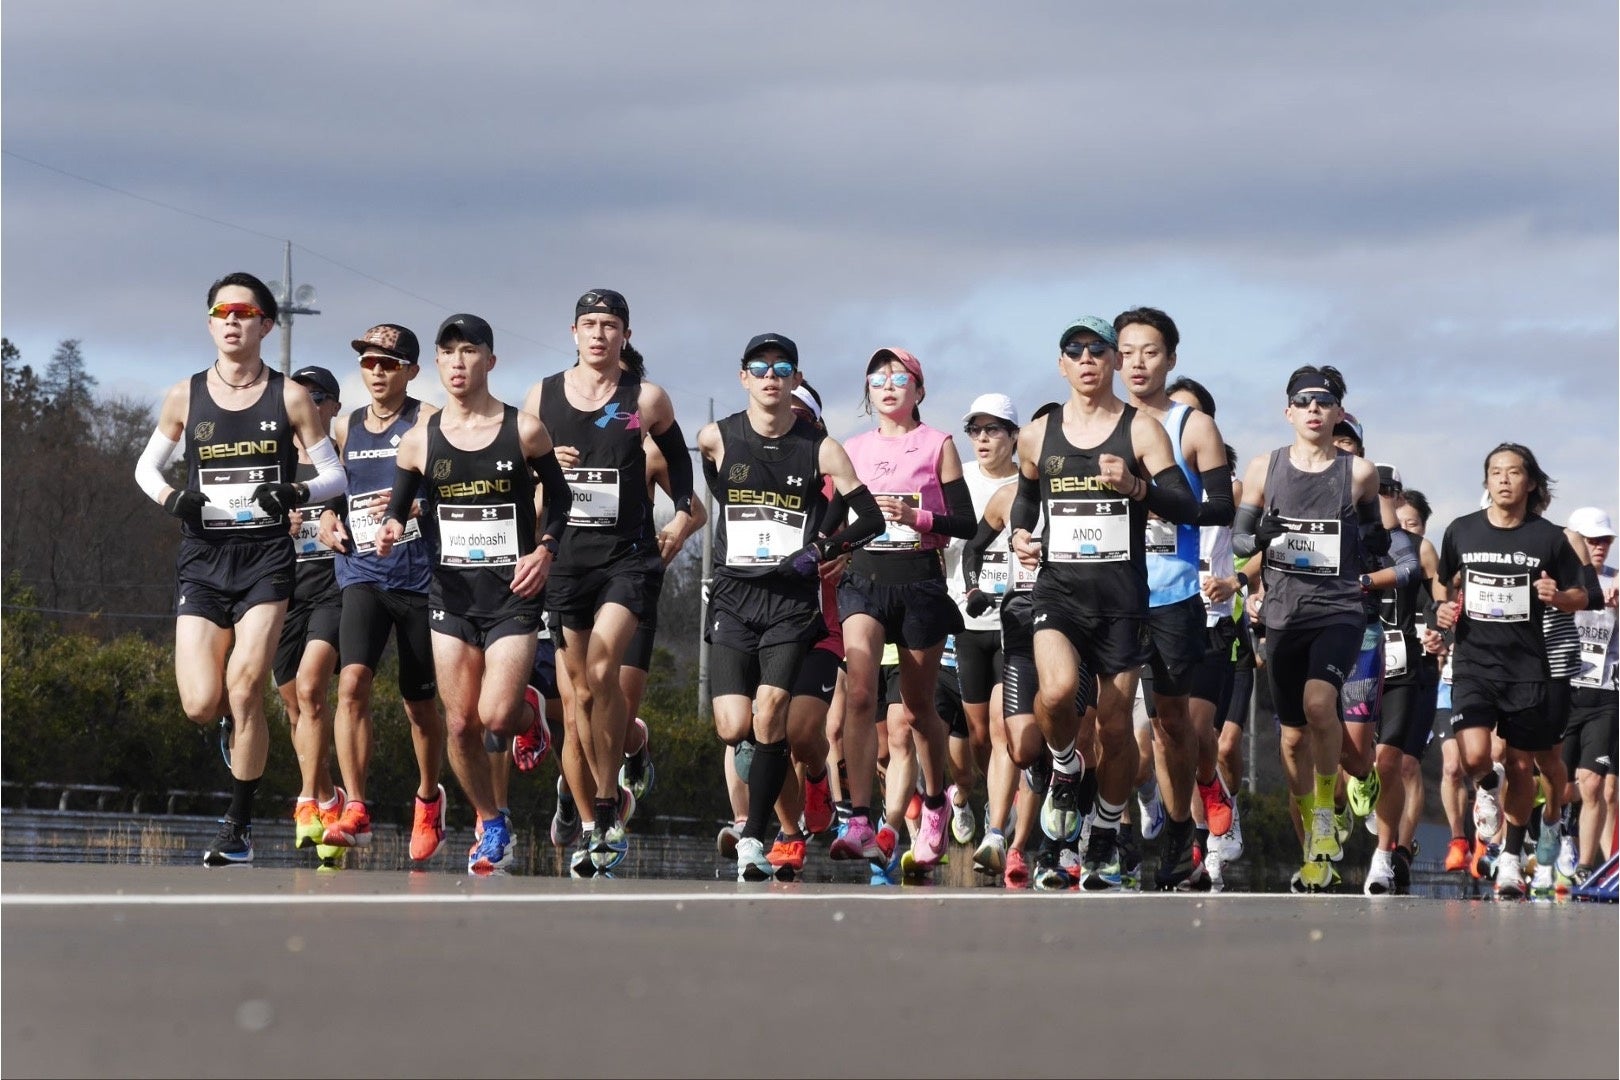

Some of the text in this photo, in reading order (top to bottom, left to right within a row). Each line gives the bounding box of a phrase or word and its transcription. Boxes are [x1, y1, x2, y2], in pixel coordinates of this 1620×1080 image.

[198, 439, 278, 460] BEYOND
[438, 479, 511, 498] BEYOND
[1050, 476, 1119, 493] BEYON
[728, 488, 801, 509] BEYOND
[449, 531, 507, 547] yuto dobashi
[1072, 528, 1103, 541] ANDO
[1287, 538, 1315, 552] KUNI
[981, 568, 1007, 581] Shige
[1018, 571, 1024, 580] B
[1479, 590, 1494, 602] 田代
